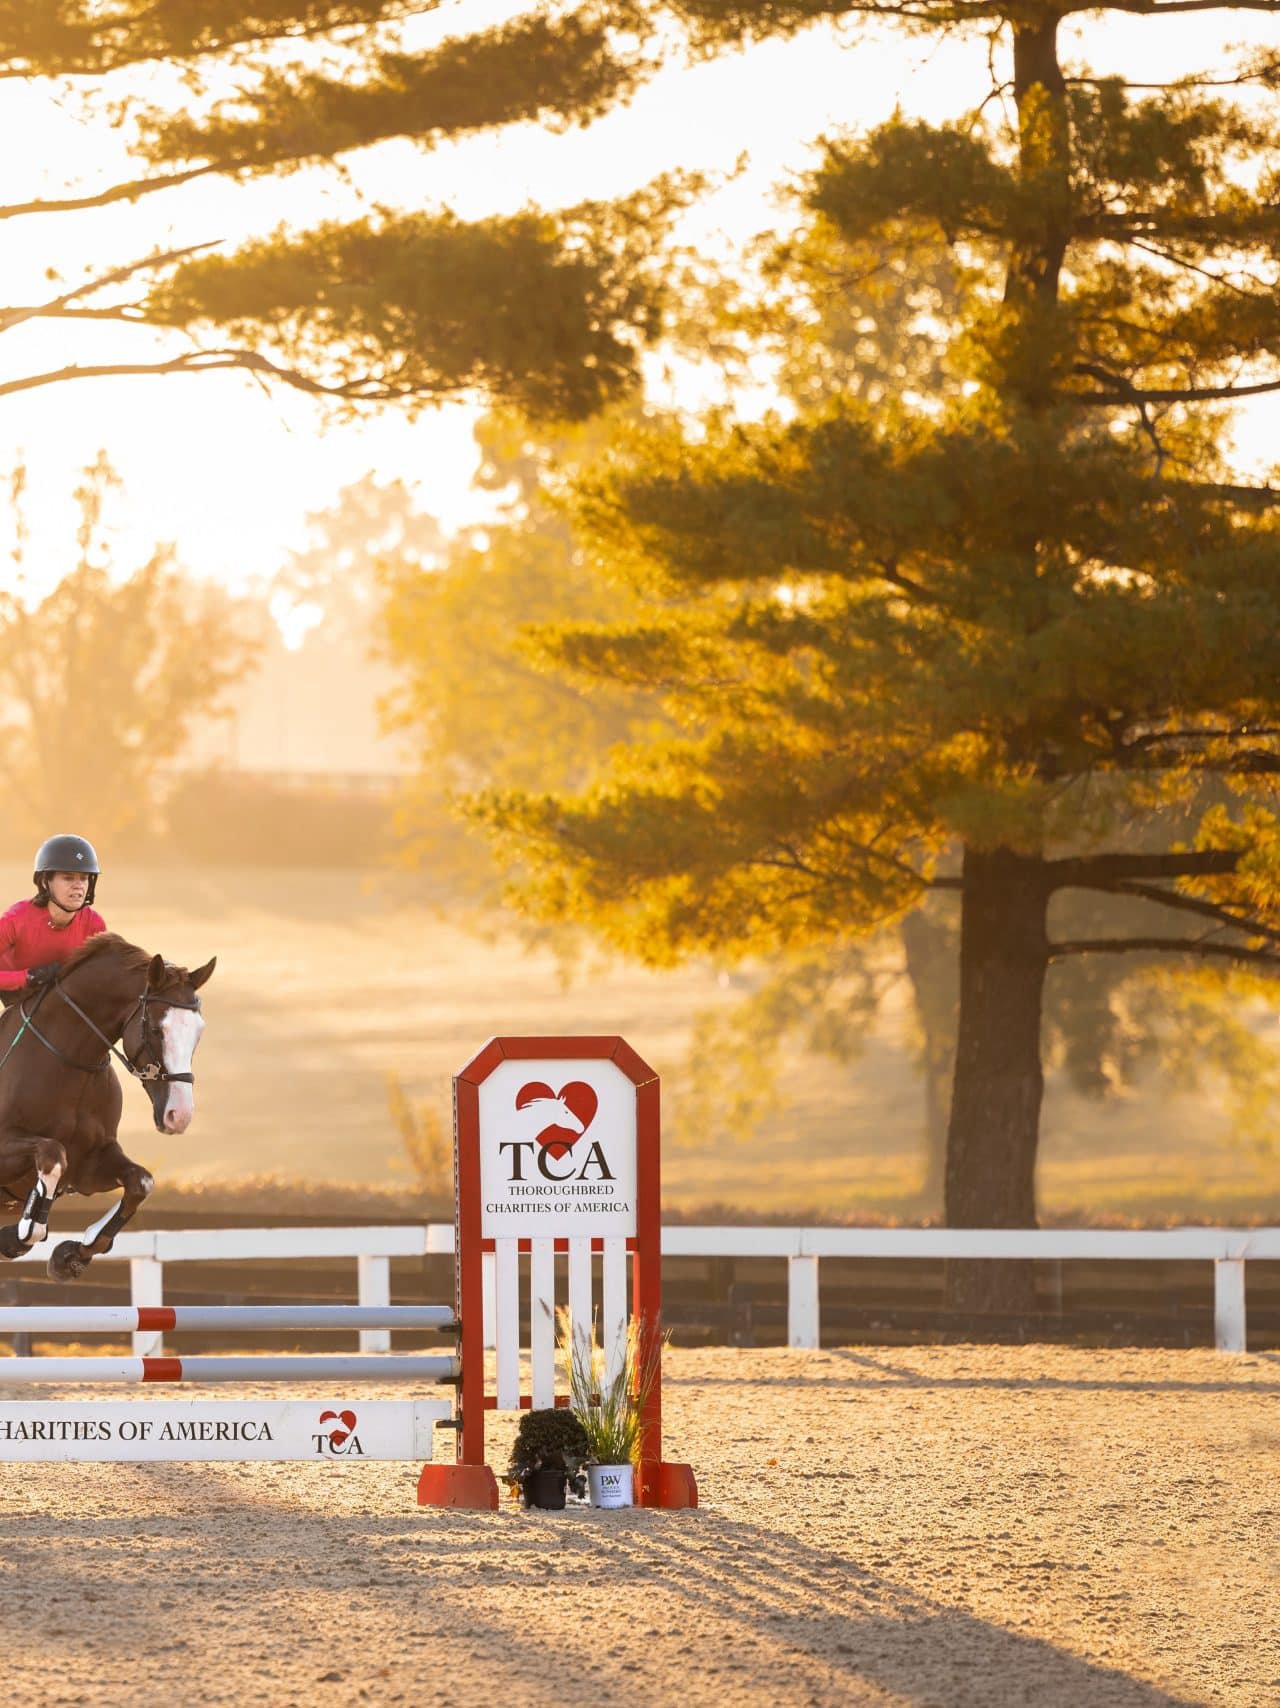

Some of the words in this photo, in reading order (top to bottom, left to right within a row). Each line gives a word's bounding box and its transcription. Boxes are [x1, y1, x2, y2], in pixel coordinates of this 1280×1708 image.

[499, 1141, 617, 1181] TCA
[508, 1185, 614, 1195] THOROUGHBRED
[486, 1203, 551, 1214] CHARITIES
[554, 1203, 571, 1213] OF
[574, 1202, 630, 1213] AMERICA
[118, 1421, 154, 1441] OF
[159, 1421, 274, 1442] AMERICA
[312, 1434, 365, 1455] TCA
